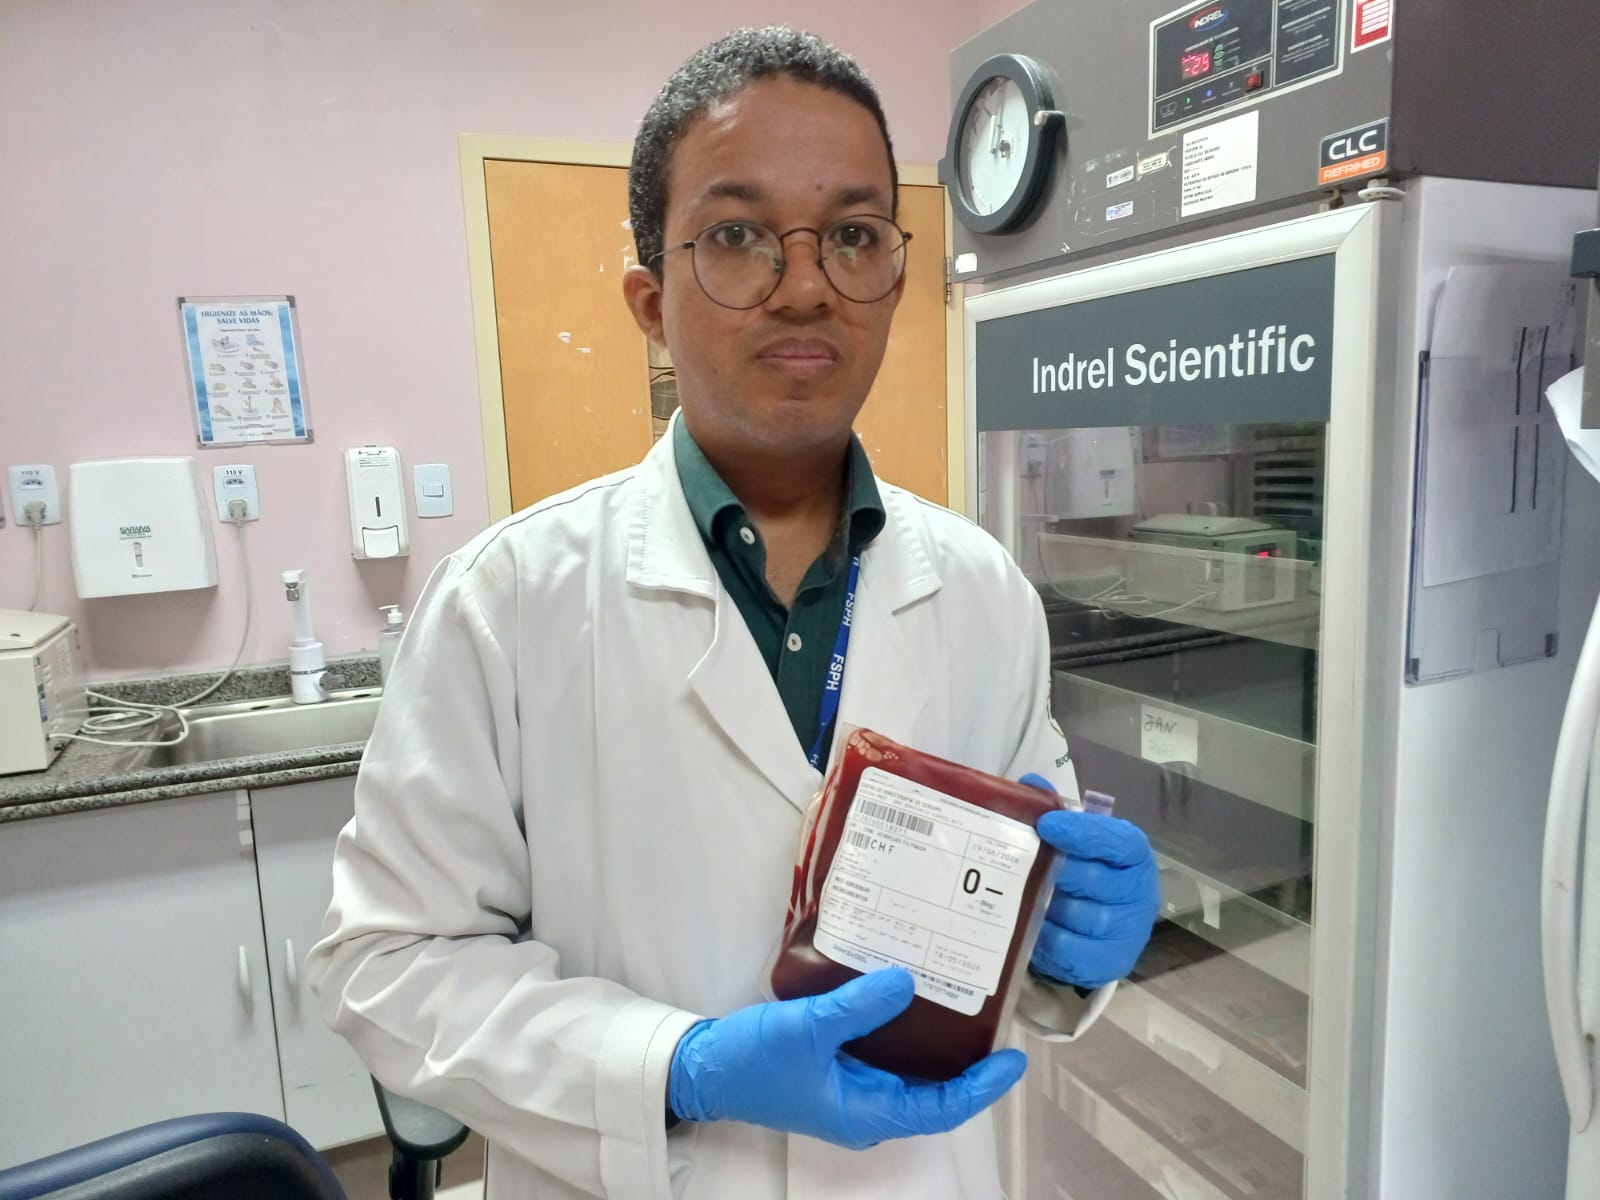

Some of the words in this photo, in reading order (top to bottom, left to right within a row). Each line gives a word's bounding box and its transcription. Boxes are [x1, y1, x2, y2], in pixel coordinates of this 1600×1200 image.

[1328, 129, 1378, 160] CLC
[1323, 157, 1381, 180] REFRIMED
[200, 310, 237, 318] HIGIENIZE
[216, 317, 237, 325] SALVE
[1032, 347, 1114, 394] Indrel
[1124, 325, 1316, 386] Scientific
[842, 592, 856, 627] FSPH
[826, 653, 845, 691] FSPH
[870, 838, 895, 855] CHF
